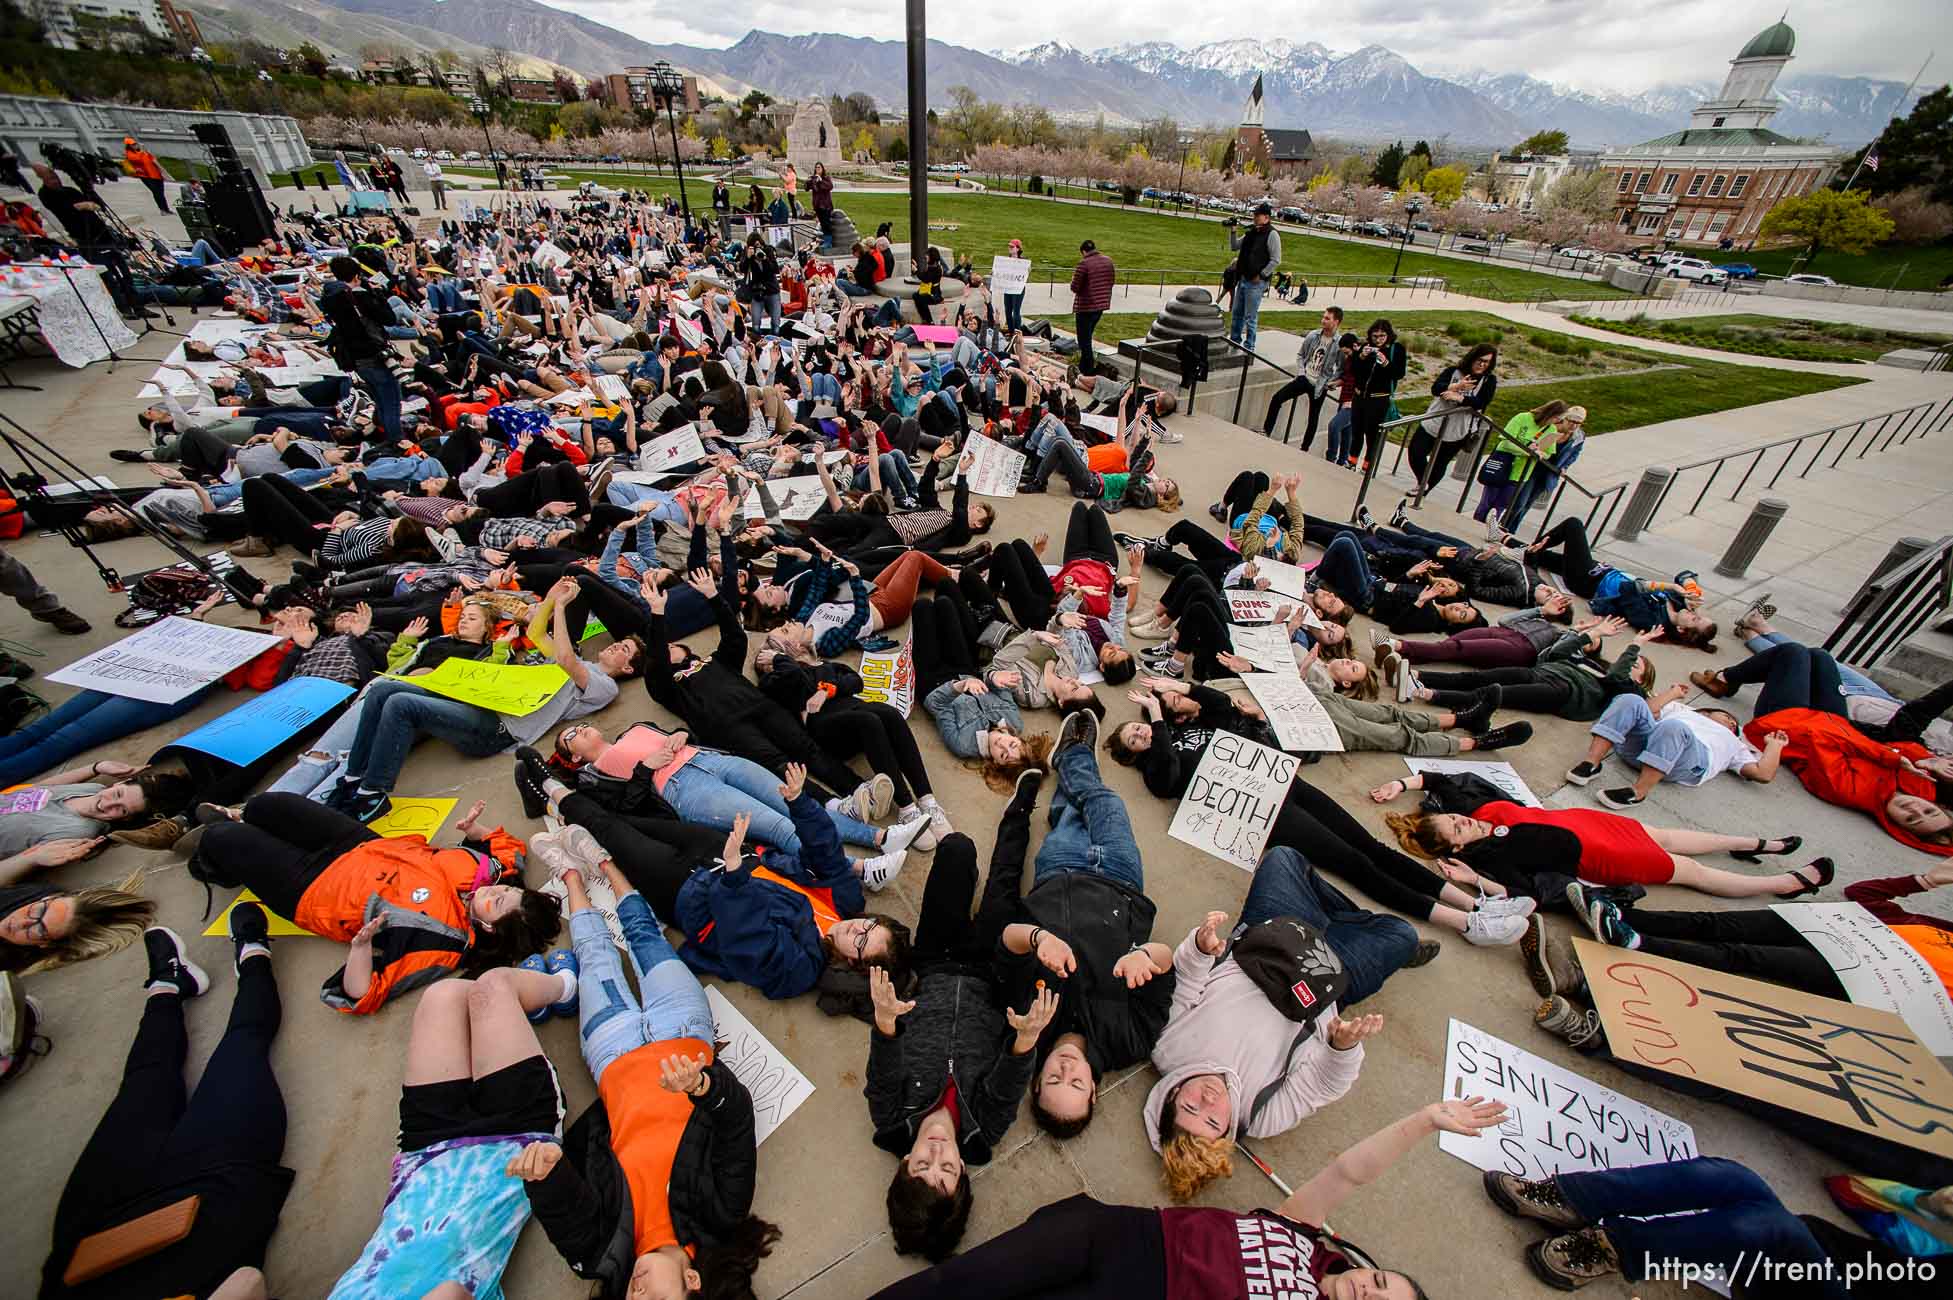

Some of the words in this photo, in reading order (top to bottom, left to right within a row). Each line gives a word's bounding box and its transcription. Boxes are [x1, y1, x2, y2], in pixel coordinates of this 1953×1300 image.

[1232, 599, 1272, 609] GUNS
[1232, 609, 1265, 620] KILL
[1212, 735, 1295, 784] GUNS
[1213, 818, 1261, 862] US
[1696, 986, 1877, 1128] NOT
[1456, 1040, 1691, 1164] MAGAZINES
[1234, 1217, 1274, 1300] MATTE
